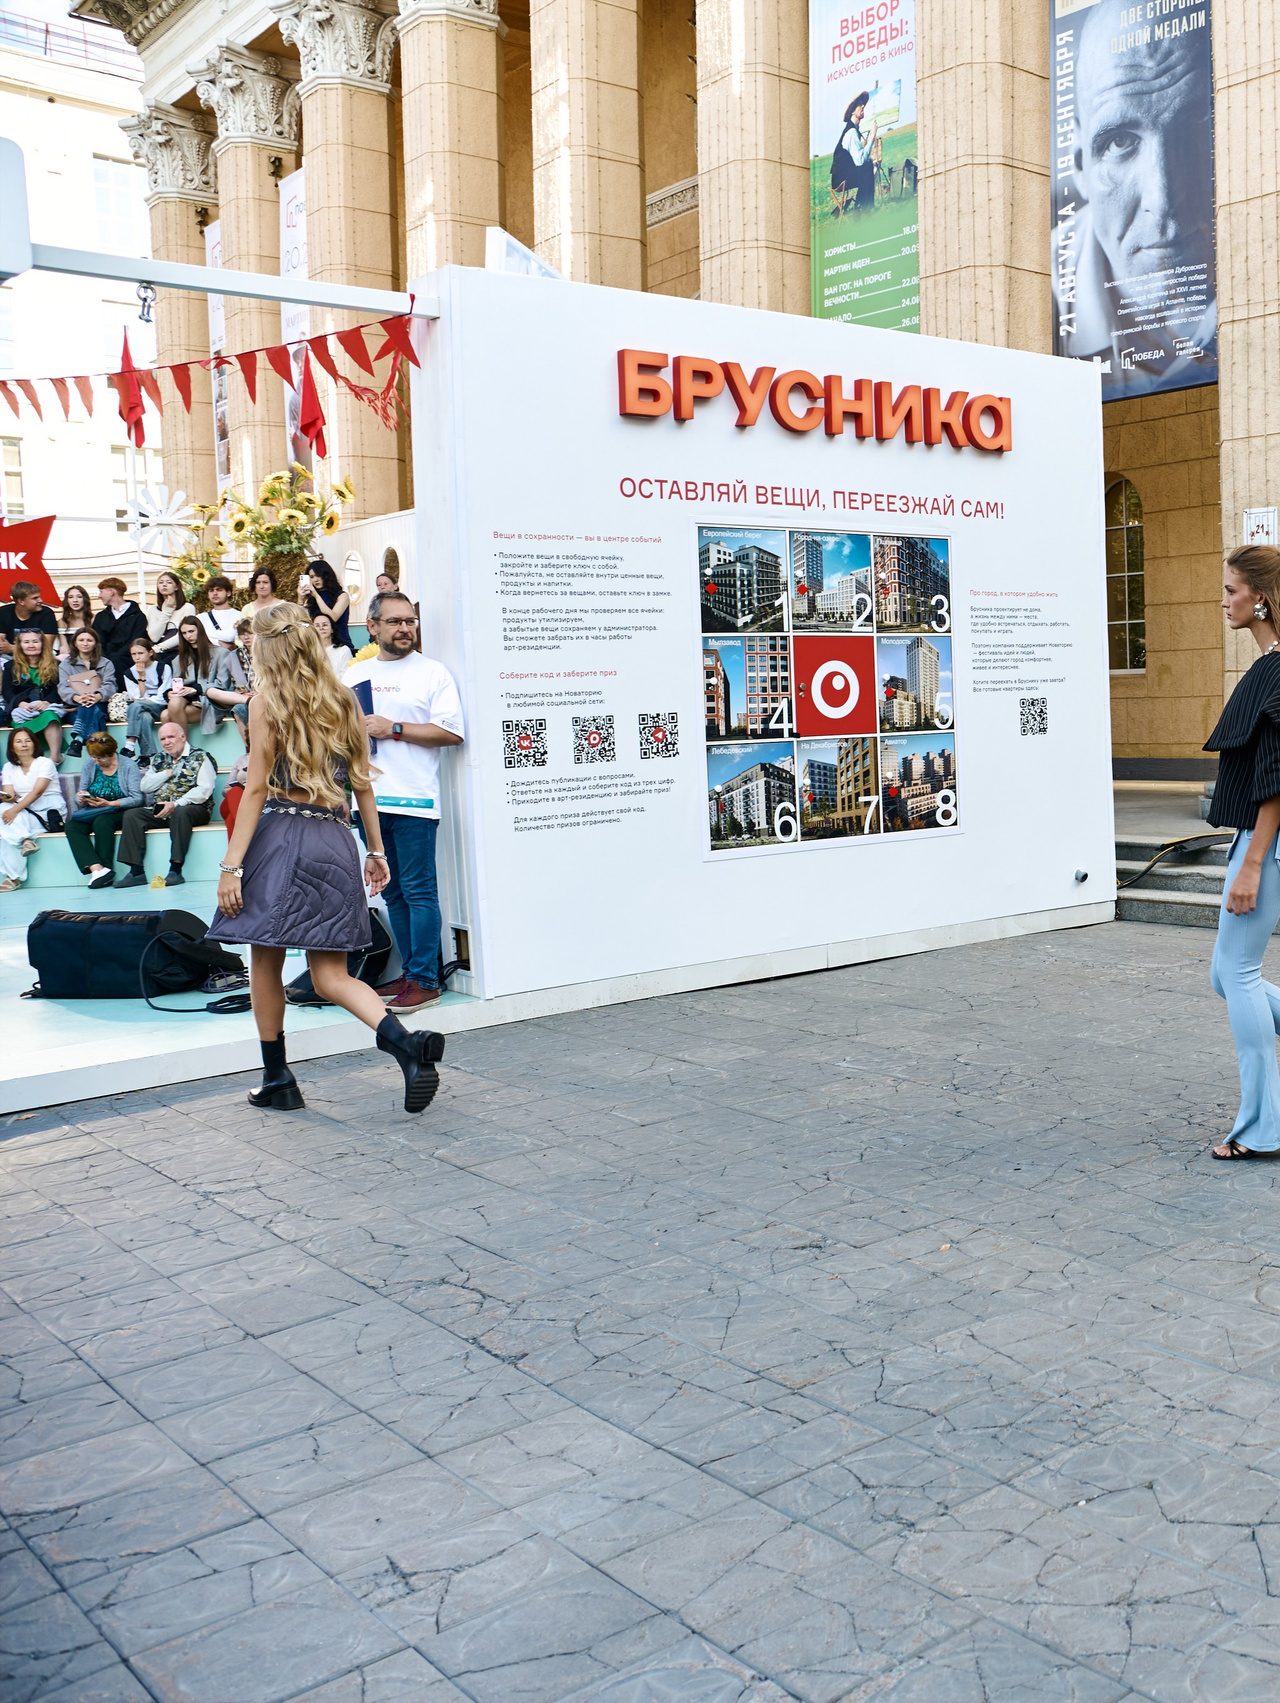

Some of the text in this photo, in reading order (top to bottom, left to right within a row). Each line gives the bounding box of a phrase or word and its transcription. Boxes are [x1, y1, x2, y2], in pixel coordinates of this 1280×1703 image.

[840, 0, 899, 37] ВЫБОР
[1120, 0, 1205, 29] ДВЕ СТОРО
[1110, 10, 1206, 54] ОДНОЙ МЕДАЛИ
[832, 19, 908, 64] ПОБЕДЫ:
[827, 41, 914, 83] ИСКУССТВО В КИНО
[1056, 29, 1077, 337] 21 АВГУСТА 19 СЕНТЯБРЯ
[824, 242, 856, 258] ХОРИСТЫ
[824, 265, 851, 277] МАРТИН
[852, 257, 870, 269] ИДЕН
[1175, 263, 1207, 274] Дубровского
[824, 271, 892, 296] ВАН ГОГ. НА ПОРОГЕ
[824, 292, 860, 308] ВЕЧНОСТИ
[1176, 341, 1194, 349] белая
[1176, 347, 1200, 356] галерея
[1132, 349, 1165, 362] ПОБЕДА
[619, 477, 1005, 520] ОСТАВЛЯЙ ВЕЩИ, ПЕРЕЕЗЖАЙ САМ!
[493, 531, 516, 540] Вещи
[524, 534, 574, 542] сохранности
[703, 529, 762, 540] Европейский берег
[1256, 524, 1264, 534] 21
[500, 562, 533, 570] закройте
[540, 562, 572, 570] заберите
[601, 554, 624, 562] ячейку,
[500, 570, 545, 579] Пожалуйста,
[532, 607, 564, 615] рабочего
[775, 592, 789, 632] 1
[852, 593, 873, 632] 2
[930, 595, 950, 632] 3
[499, 671, 538, 680] Соберите
[563, 669, 598, 678] заберите
[505, 691, 553, 699] Подпишитесь
[564, 690, 602, 698] Новаторию
[513, 700, 545, 708] любимой
[546, 699, 587, 707] социальной
[934, 692, 954, 729] 5
[769, 698, 793, 738] 4
[884, 738, 907, 746] Авиатор
[511, 778, 550, 788] Дождитесь
[551, 775, 592, 785] публикации
[598, 773, 635, 782] вопросами.
[858, 796, 879, 834] 7
[935, 789, 957, 826] 8
[514, 817, 622, 832] Количество призов ограничено.
[774, 802, 797, 843] 6
